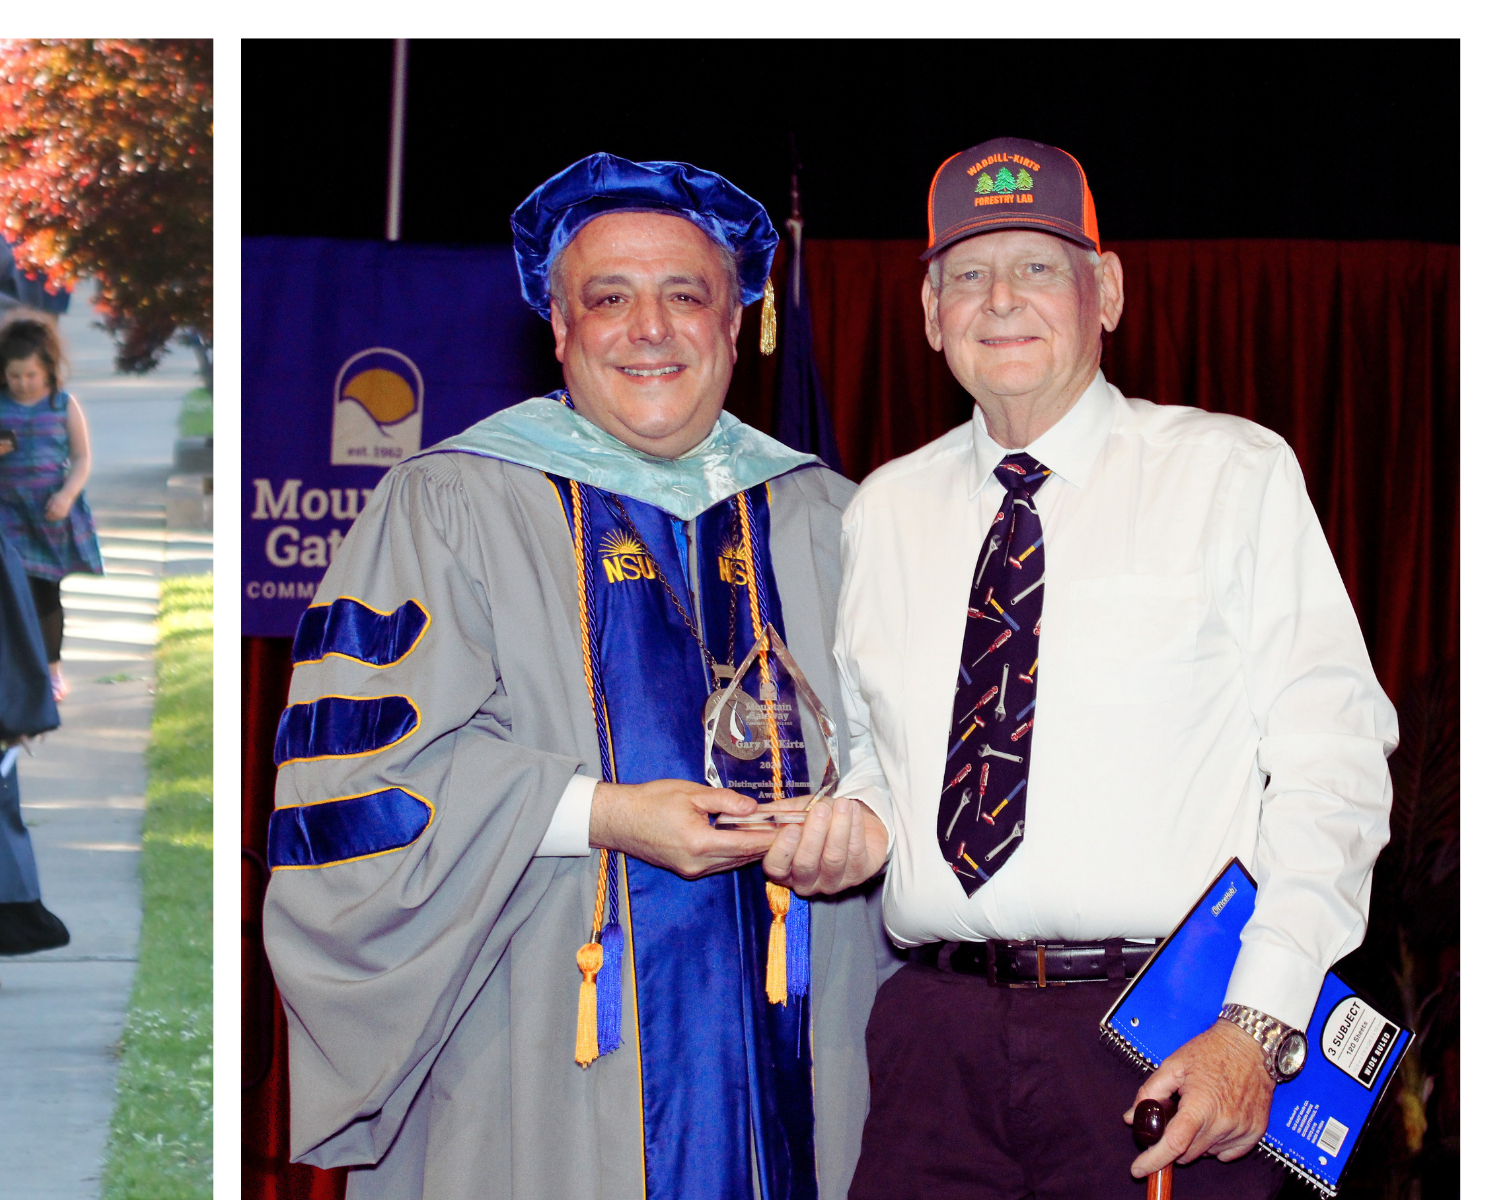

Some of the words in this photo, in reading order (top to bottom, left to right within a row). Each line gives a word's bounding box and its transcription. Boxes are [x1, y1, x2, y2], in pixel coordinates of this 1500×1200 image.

[966, 152, 1041, 176] WADDILL-KIRTS
[974, 194, 1015, 207] FORESTRY
[1016, 193, 1034, 203] LAB
[602, 555, 656, 584] NSU
[718, 556, 748, 586] NS
[246, 580, 319, 599] COMM
[736, 740, 760, 750] Gary
[779, 740, 805, 749] Kirts
[1327, 1047, 1337, 1056] 3
[1332, 1001, 1361, 1047] SUBJECT
[1346, 1042, 1356, 1056] 120
[1353, 1021, 1368, 1043] Sheets
[1363, 1056, 1378, 1076] WIDE
[1374, 1032, 1391, 1057] RULED
